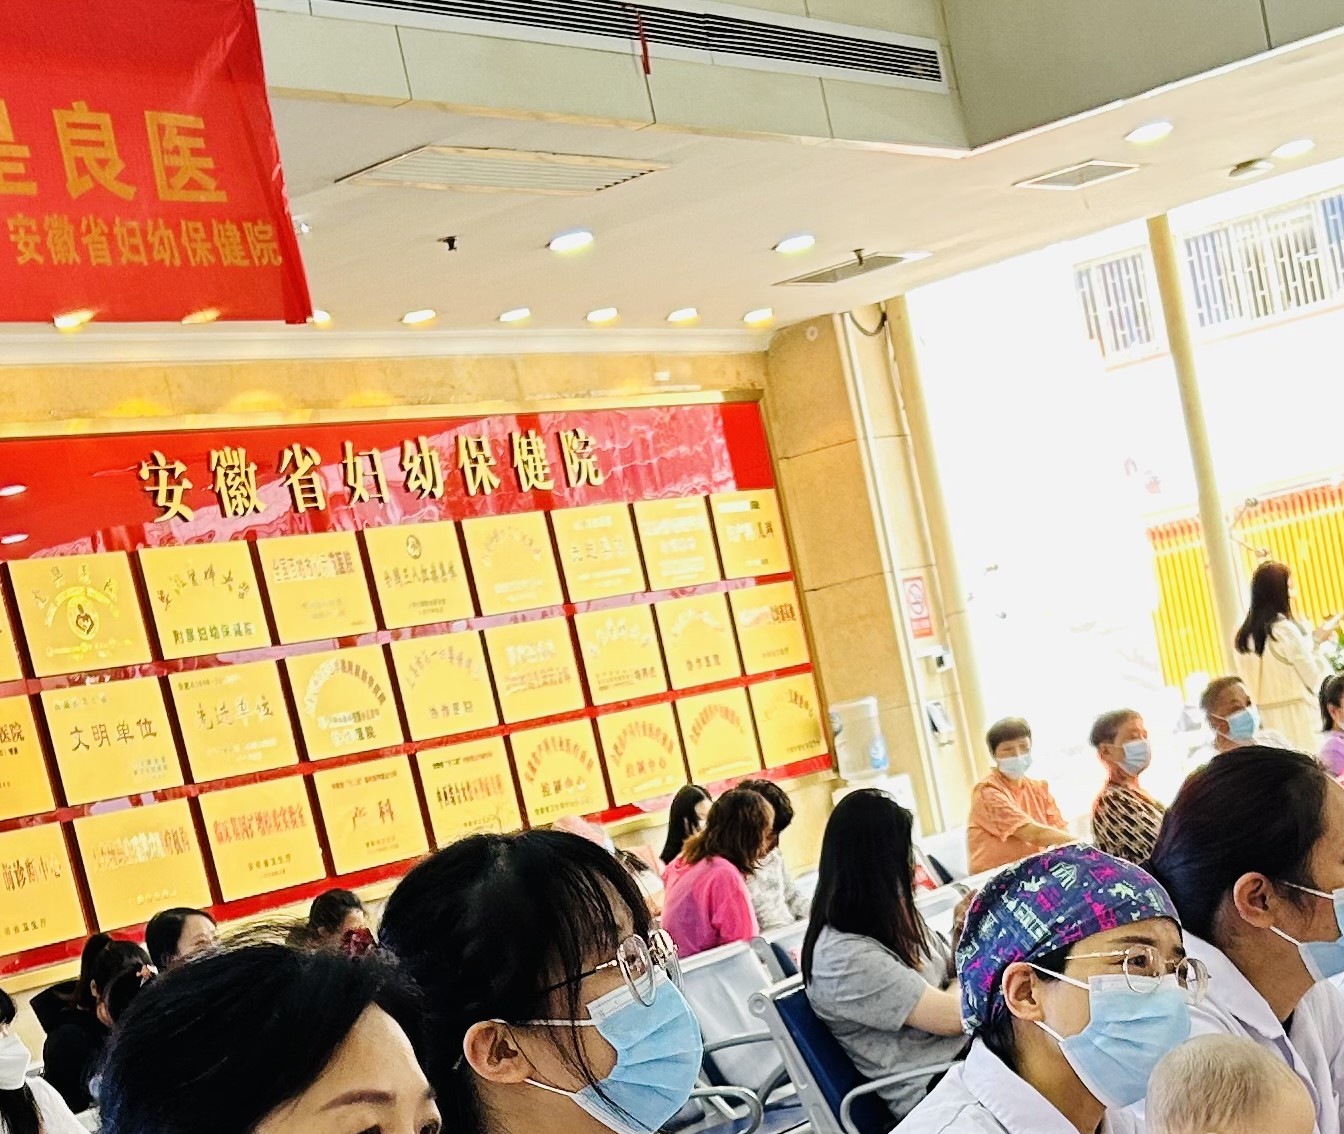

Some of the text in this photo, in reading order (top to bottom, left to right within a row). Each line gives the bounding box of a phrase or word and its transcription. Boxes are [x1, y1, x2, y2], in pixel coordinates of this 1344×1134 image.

[6, 213, 283, 267] 安徽省妇幼保健院
[138, 428, 604, 523] 安徽省妇幼保健院
[69, 717, 157, 752] 文明单位
